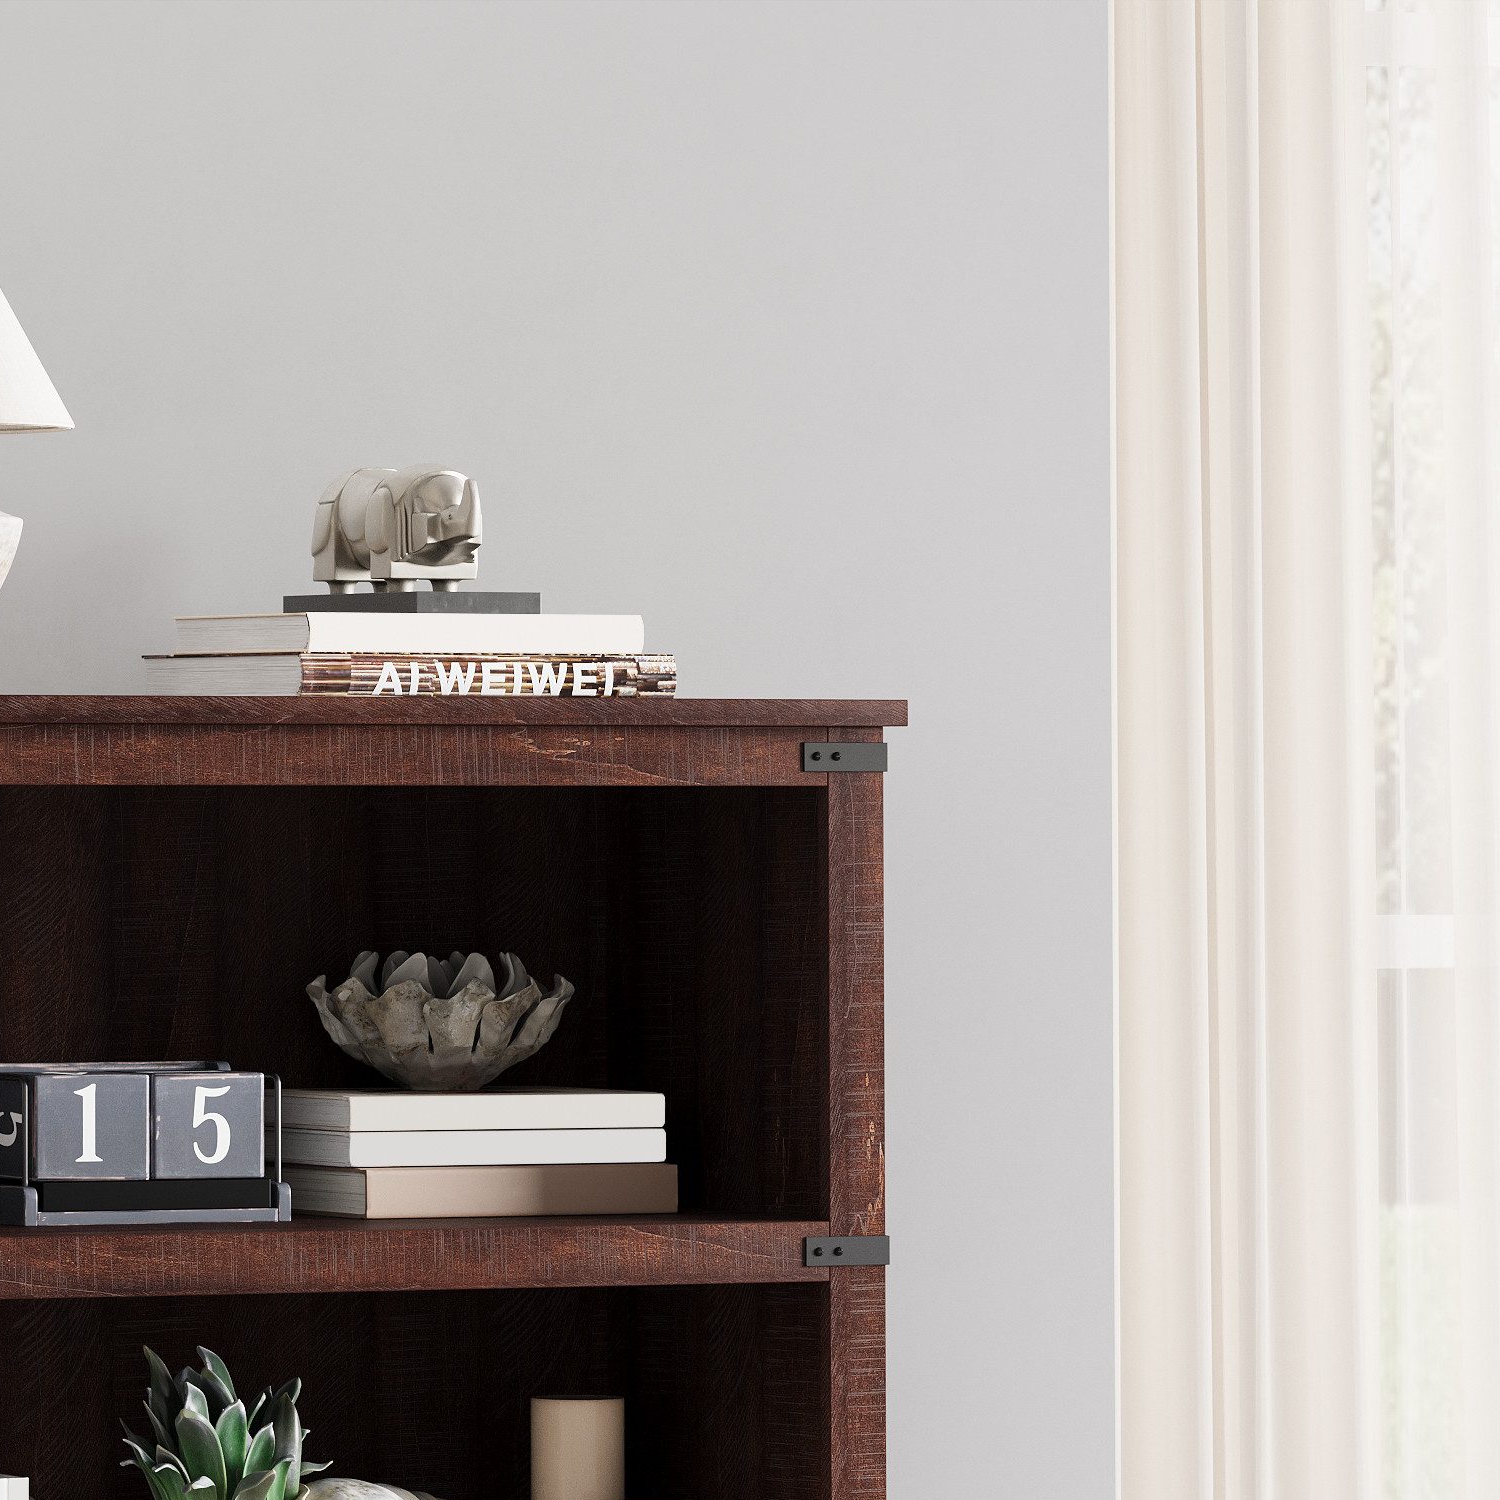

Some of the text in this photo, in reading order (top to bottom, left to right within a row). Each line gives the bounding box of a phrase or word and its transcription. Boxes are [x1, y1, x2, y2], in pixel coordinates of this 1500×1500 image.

[372, 661, 614, 696] AI WEIWEI
[73, 1083, 231, 1165] 1 5
